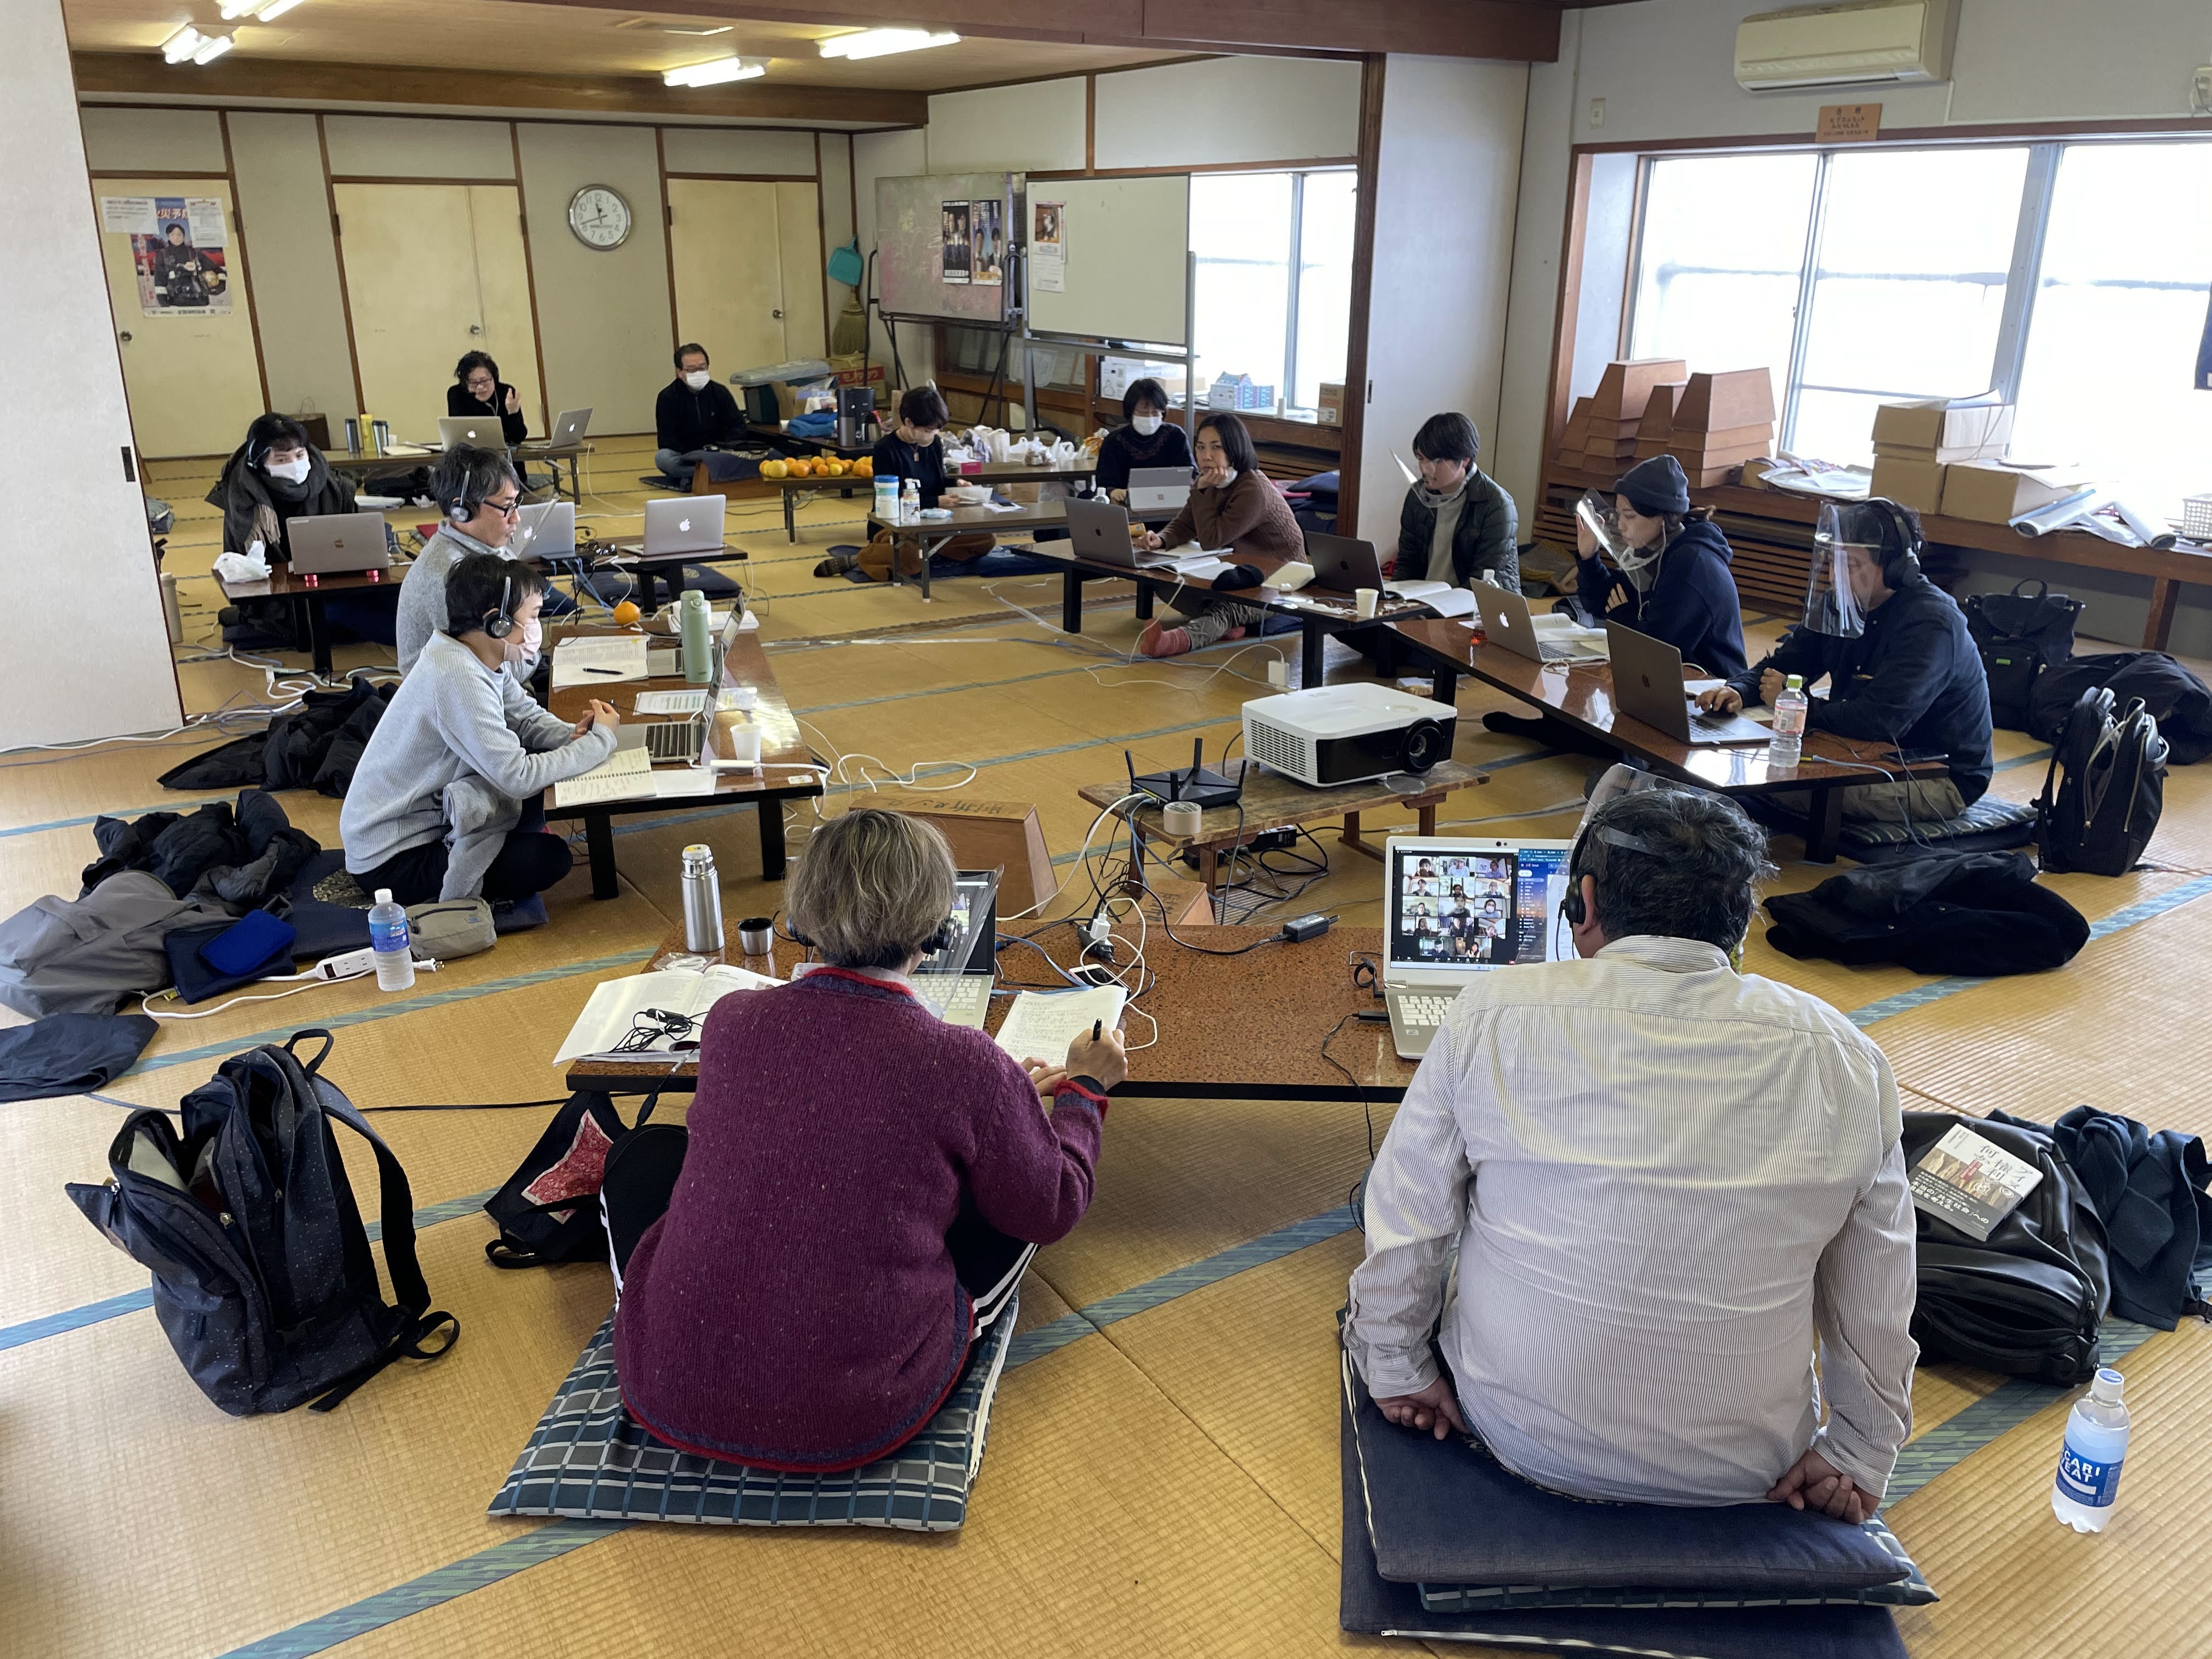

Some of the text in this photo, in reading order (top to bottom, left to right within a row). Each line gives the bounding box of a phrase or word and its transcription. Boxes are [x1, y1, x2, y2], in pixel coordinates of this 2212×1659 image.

[586, 196, 592, 204] 11
[579, 203, 586, 212] 10
[612, 204, 617, 212] 2
[591, 231, 595, 240] 7
[599, 233, 605, 241] 6
[2062, 1448, 2101, 1476] CARI
